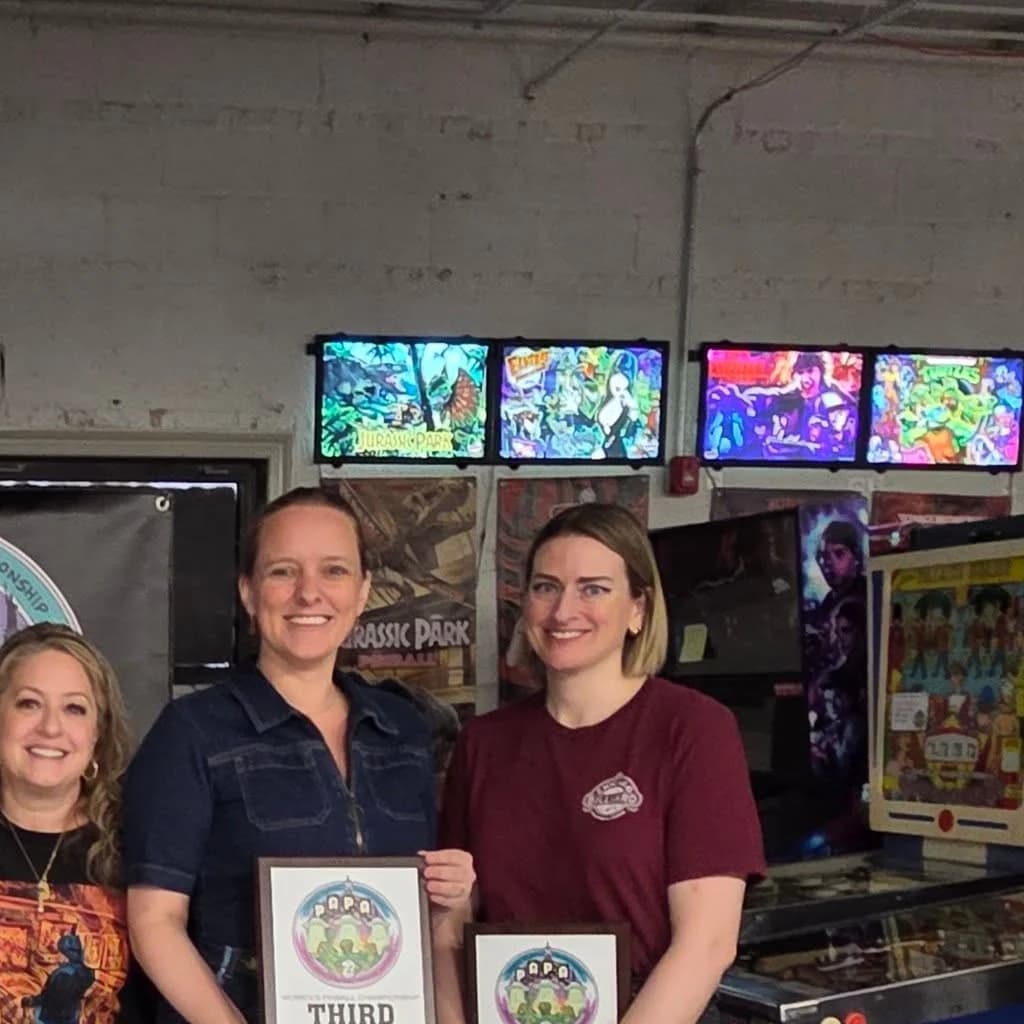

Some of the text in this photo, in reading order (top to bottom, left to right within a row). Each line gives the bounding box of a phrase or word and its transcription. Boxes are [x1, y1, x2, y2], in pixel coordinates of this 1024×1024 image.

[414, 617, 470, 650] PARK
[315, 896, 371, 917] PAPA
[517, 961, 569, 980] PAPA
